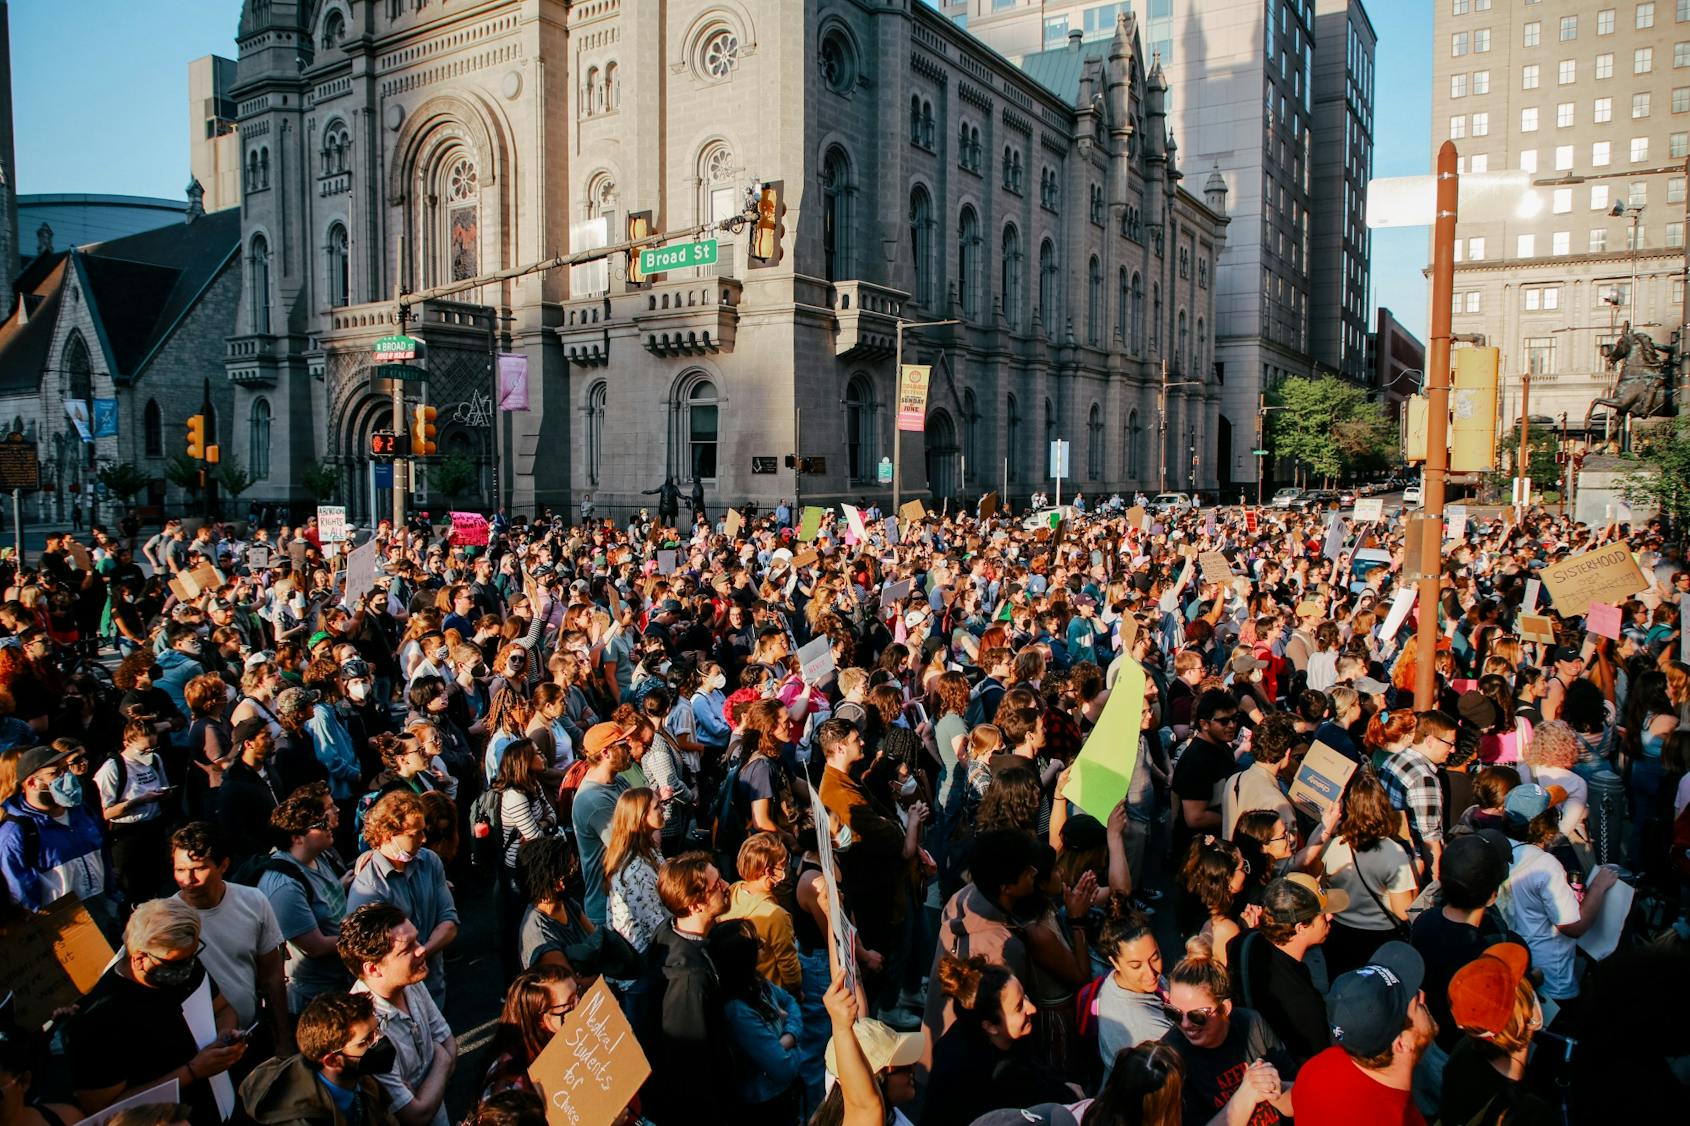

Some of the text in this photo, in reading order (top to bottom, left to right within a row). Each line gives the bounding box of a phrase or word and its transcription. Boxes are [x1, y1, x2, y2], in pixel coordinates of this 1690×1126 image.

[646, 244, 710, 268] Broad St
[382, 341, 406, 351] BROAD
[901, 397, 925, 405] SUNDAY
[387, 436, 394, 451] 2
[320, 517, 343, 527] RIGHTS
[330, 527, 344, 538] ALL
[1552, 550, 1626, 584] SISTERHOOD
[579, 990, 625, 1055] Medical
[565, 1027, 612, 1091] Students
[563, 1062, 584, 1090] for
